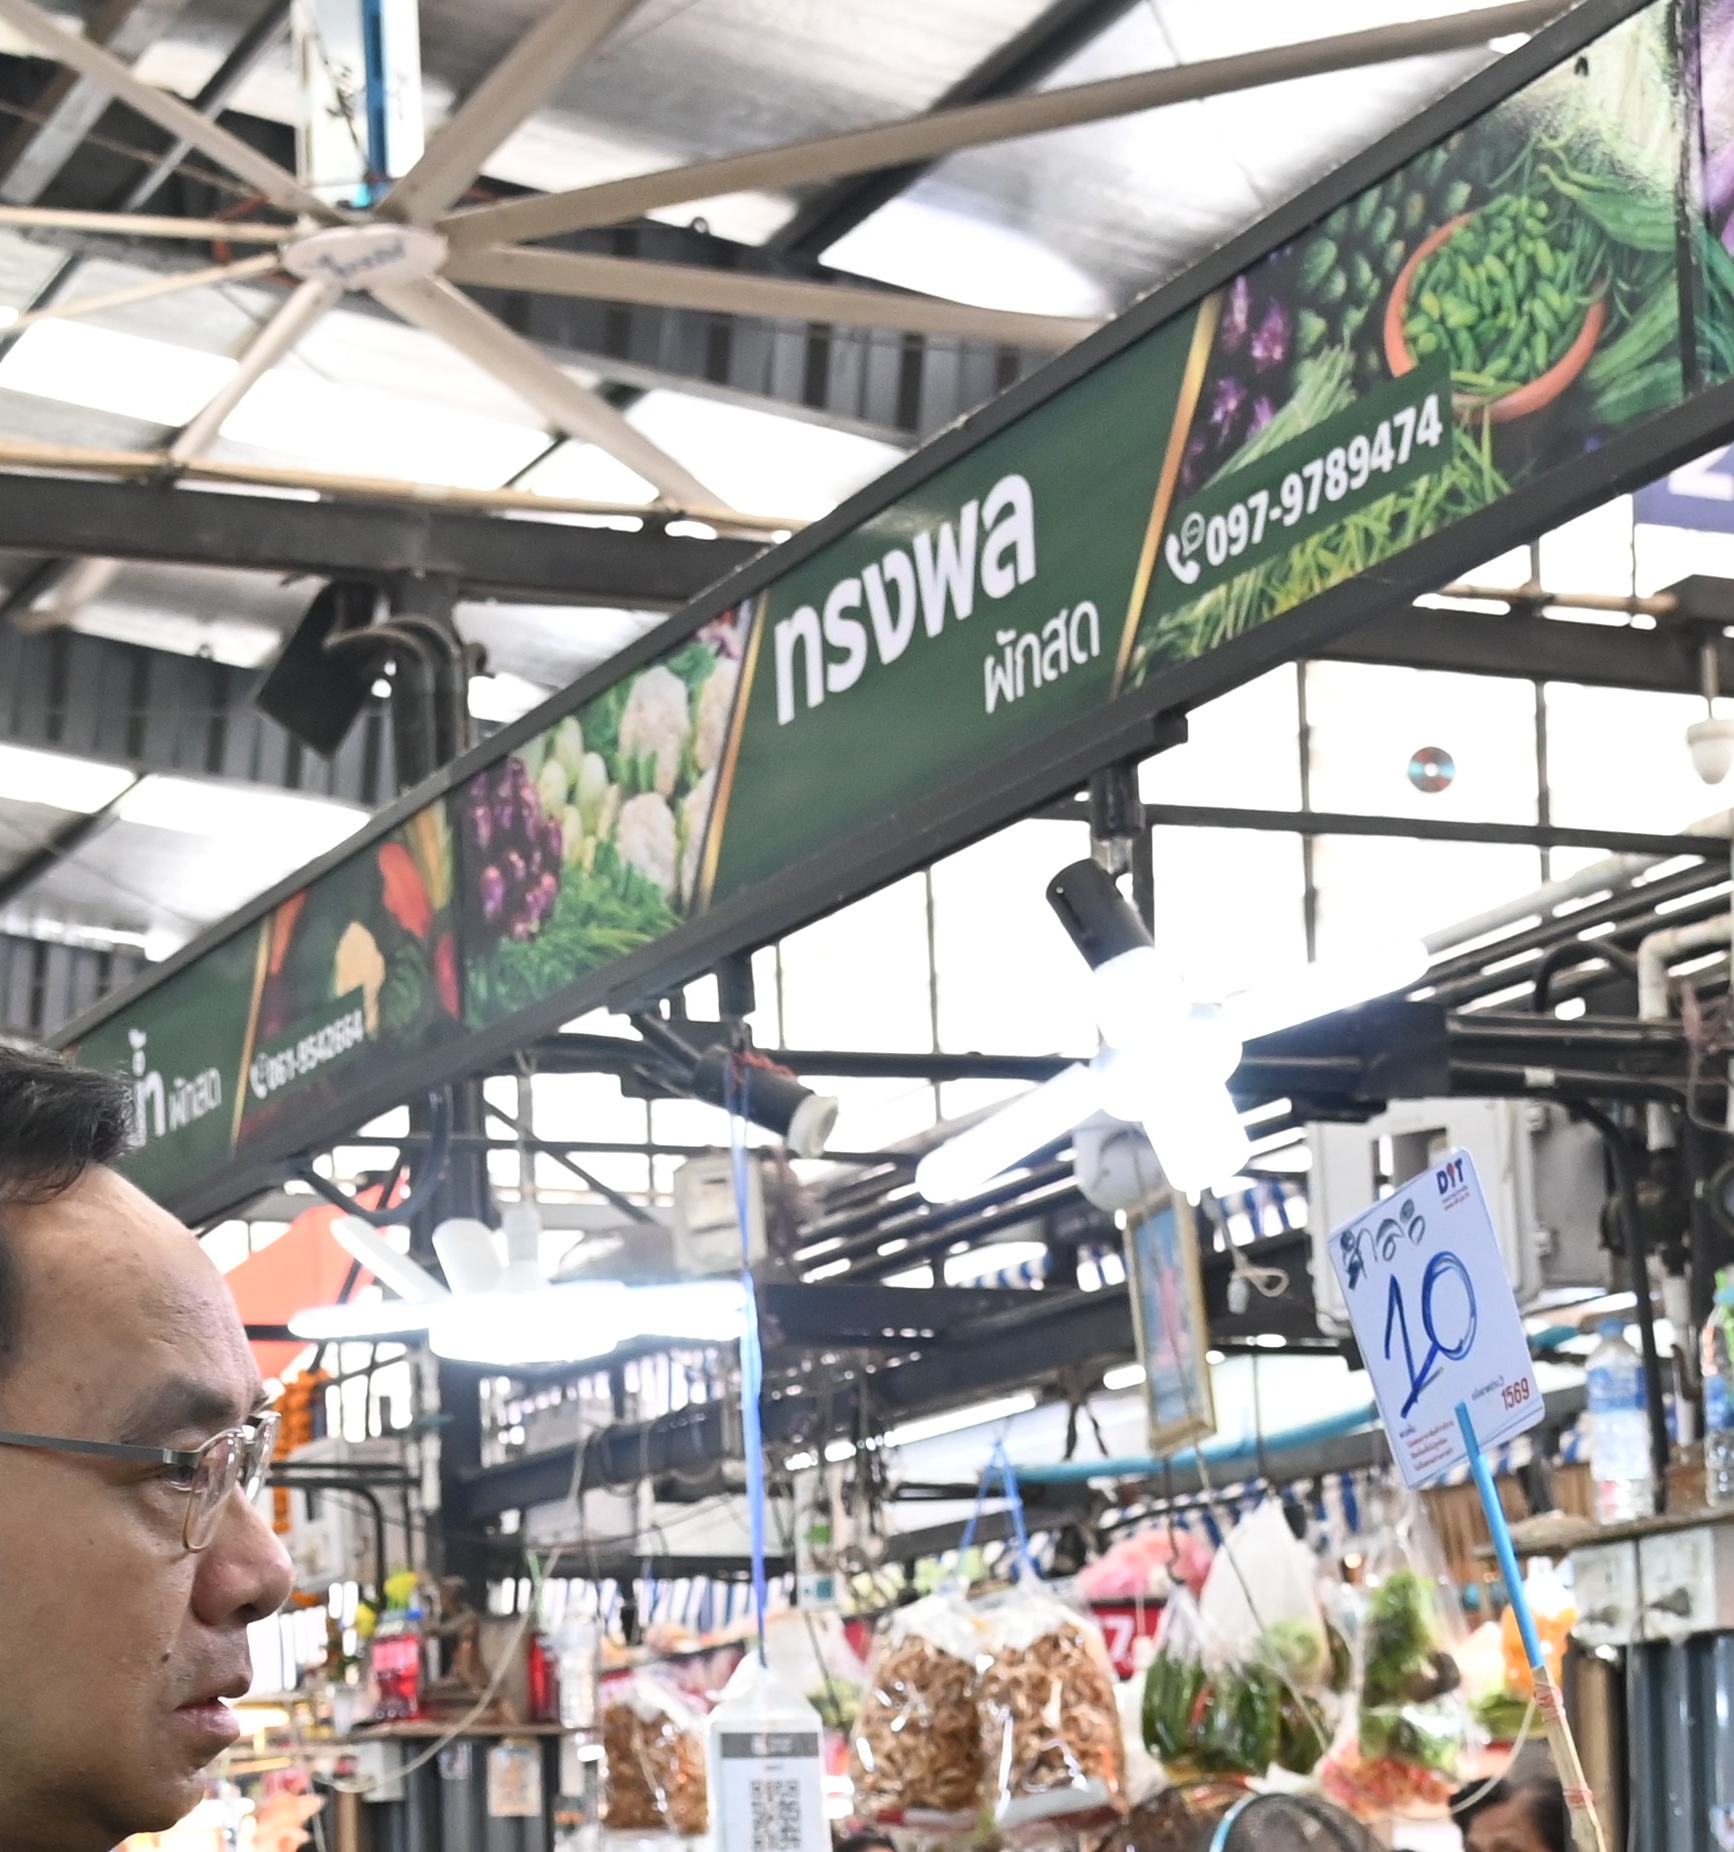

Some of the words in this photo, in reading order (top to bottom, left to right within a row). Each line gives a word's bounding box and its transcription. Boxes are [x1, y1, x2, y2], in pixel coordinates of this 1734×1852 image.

[1204, 394, 1443, 567] 097-9789474
[775, 474, 1038, 727] ทรงพล
[984, 600, 1102, 716] ผักสด
[1501, 1377, 1531, 1411] 1569
